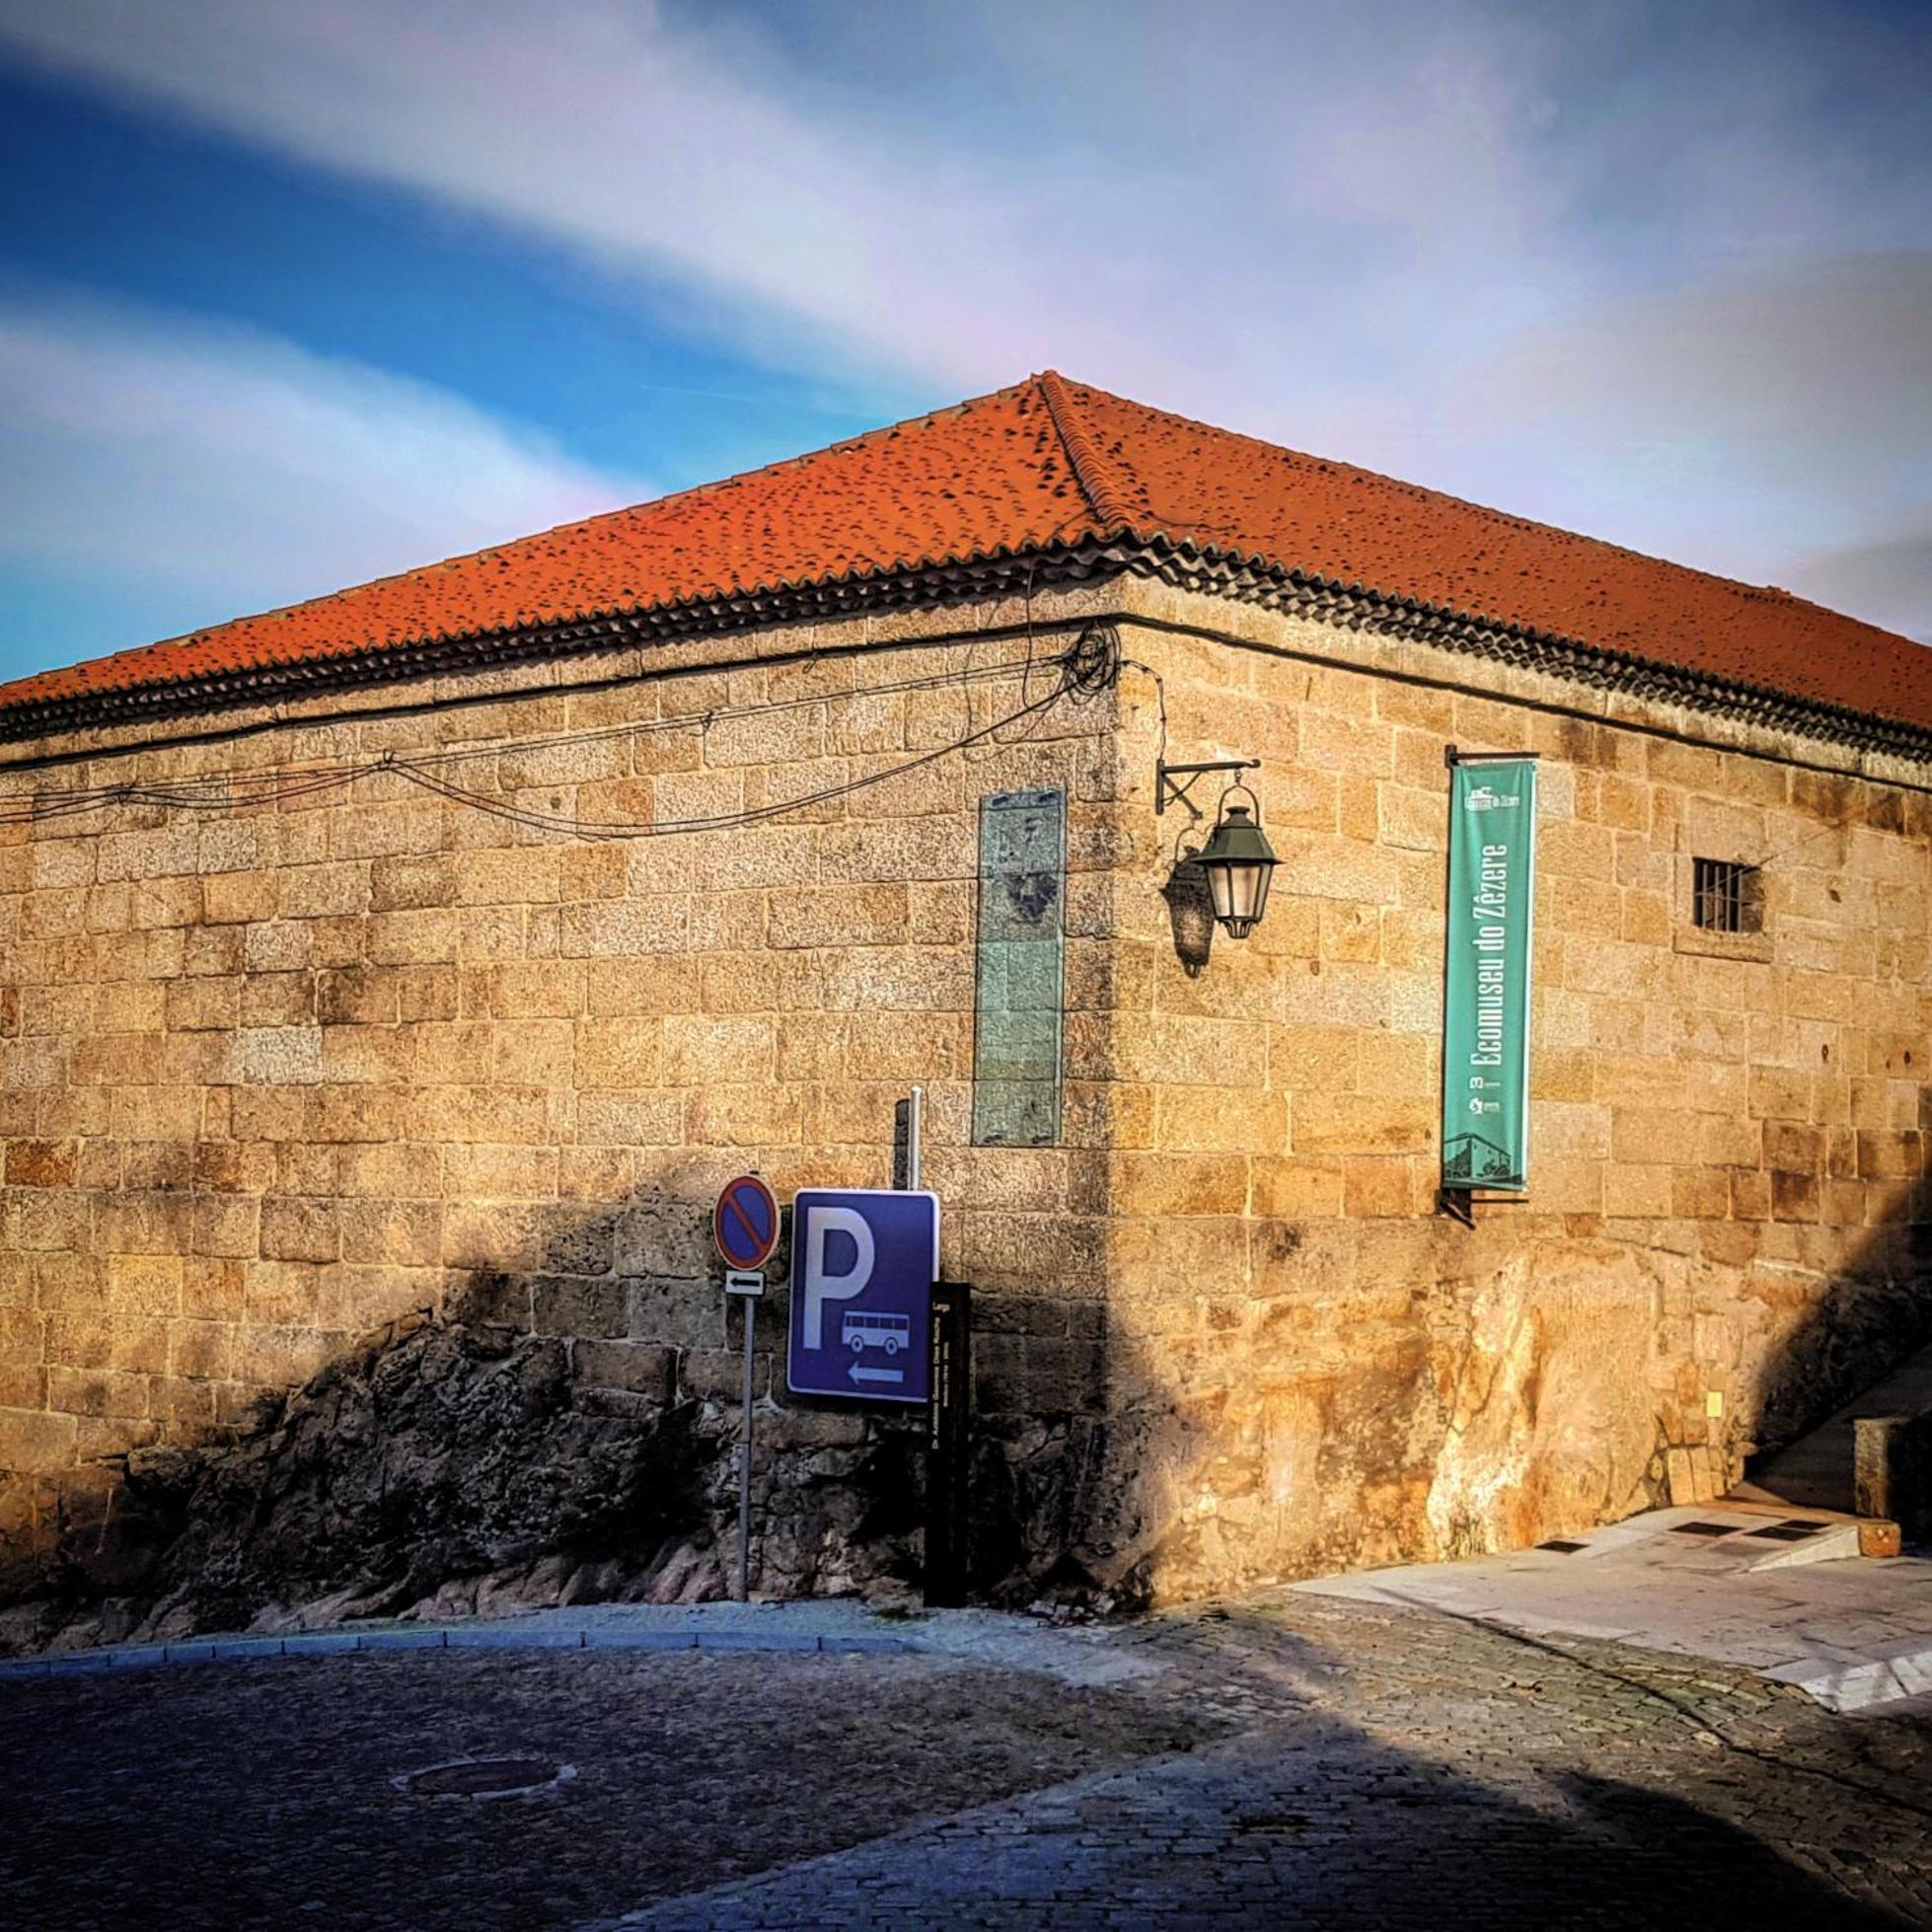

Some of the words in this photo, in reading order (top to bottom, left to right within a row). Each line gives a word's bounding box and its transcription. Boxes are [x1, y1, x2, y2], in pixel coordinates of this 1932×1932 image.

[1472, 844, 1508, 920] Zêzere
[1472, 926, 1506, 951] do
[1470, 958, 1505, 1066] Ecomuseu
[803, 1206, 875, 1351] P
